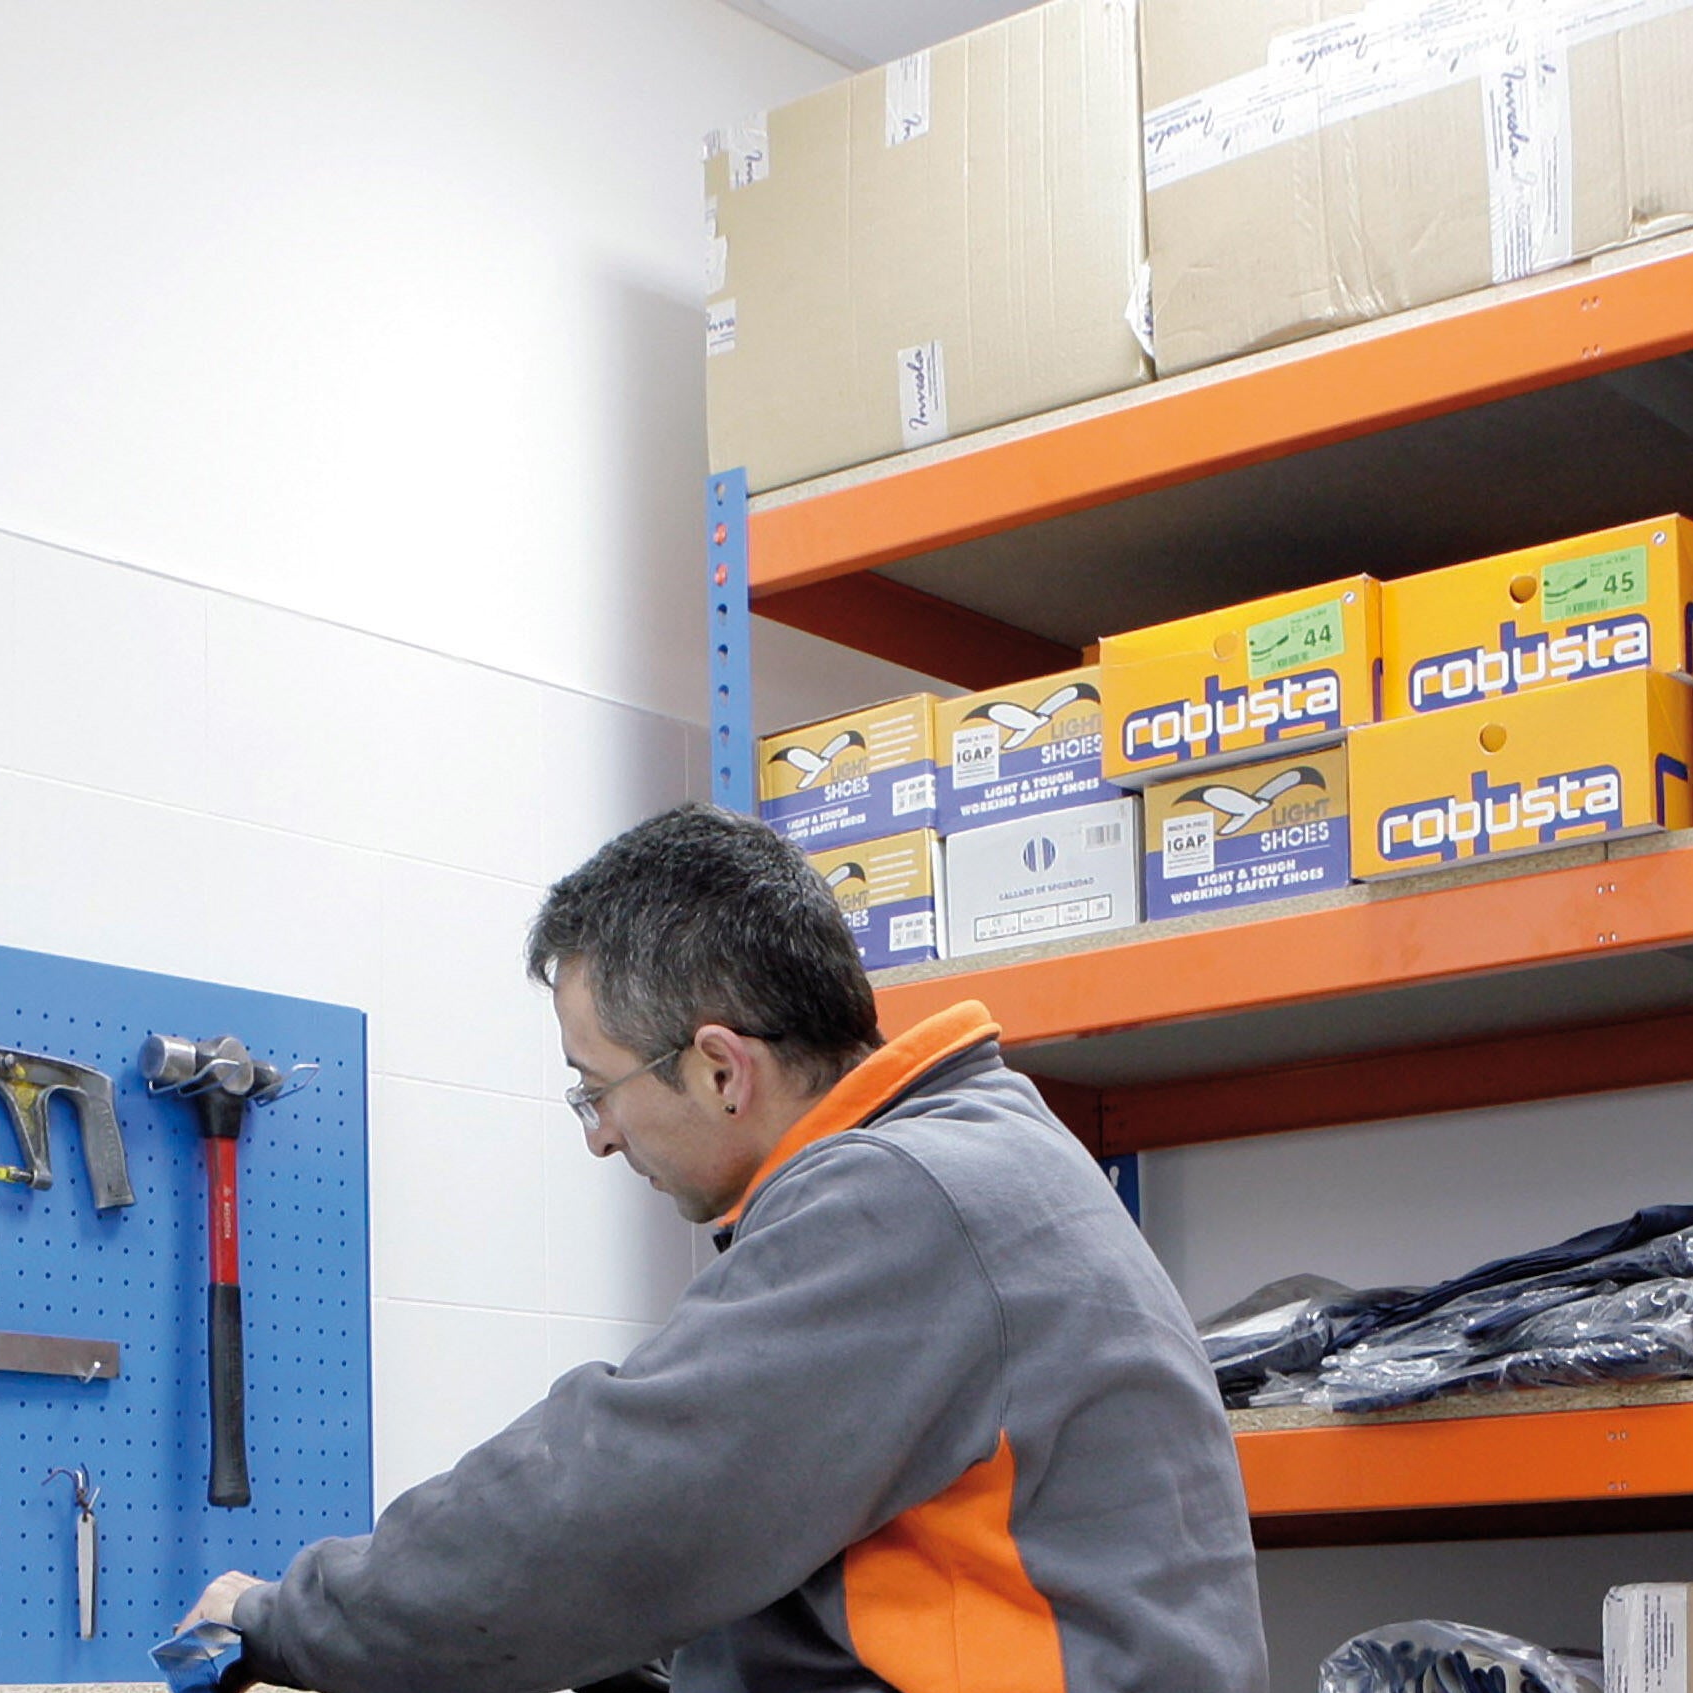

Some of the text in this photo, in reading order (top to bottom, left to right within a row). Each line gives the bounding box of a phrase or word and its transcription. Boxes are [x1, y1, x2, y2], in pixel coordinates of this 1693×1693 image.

[1603, 571, 1634, 595] 45
[1304, 624, 1331, 647] 44
[1412, 621, 1649, 702] robusta
[1124, 676, 1339, 757] robusta
[957, 746, 993, 765] IGAP
[1041, 734, 1102, 764] SHOES
[825, 776, 869, 802] SHOES
[960, 778, 1099, 816] WORKING SAFETY SHOES
[984, 782, 1018, 799] LIGHT
[1033, 770, 1074, 788] TOUGH
[1272, 797, 1329, 827] LIGHT
[1381, 771, 1619, 855] robusta
[1168, 834, 1206, 853] IGAP
[1261, 821, 1329, 852] SHOES
[1171, 868, 1324, 904] WORKING SAFETY SHOES
[1197, 859, 1296, 887] LIGHT & TOUGH
